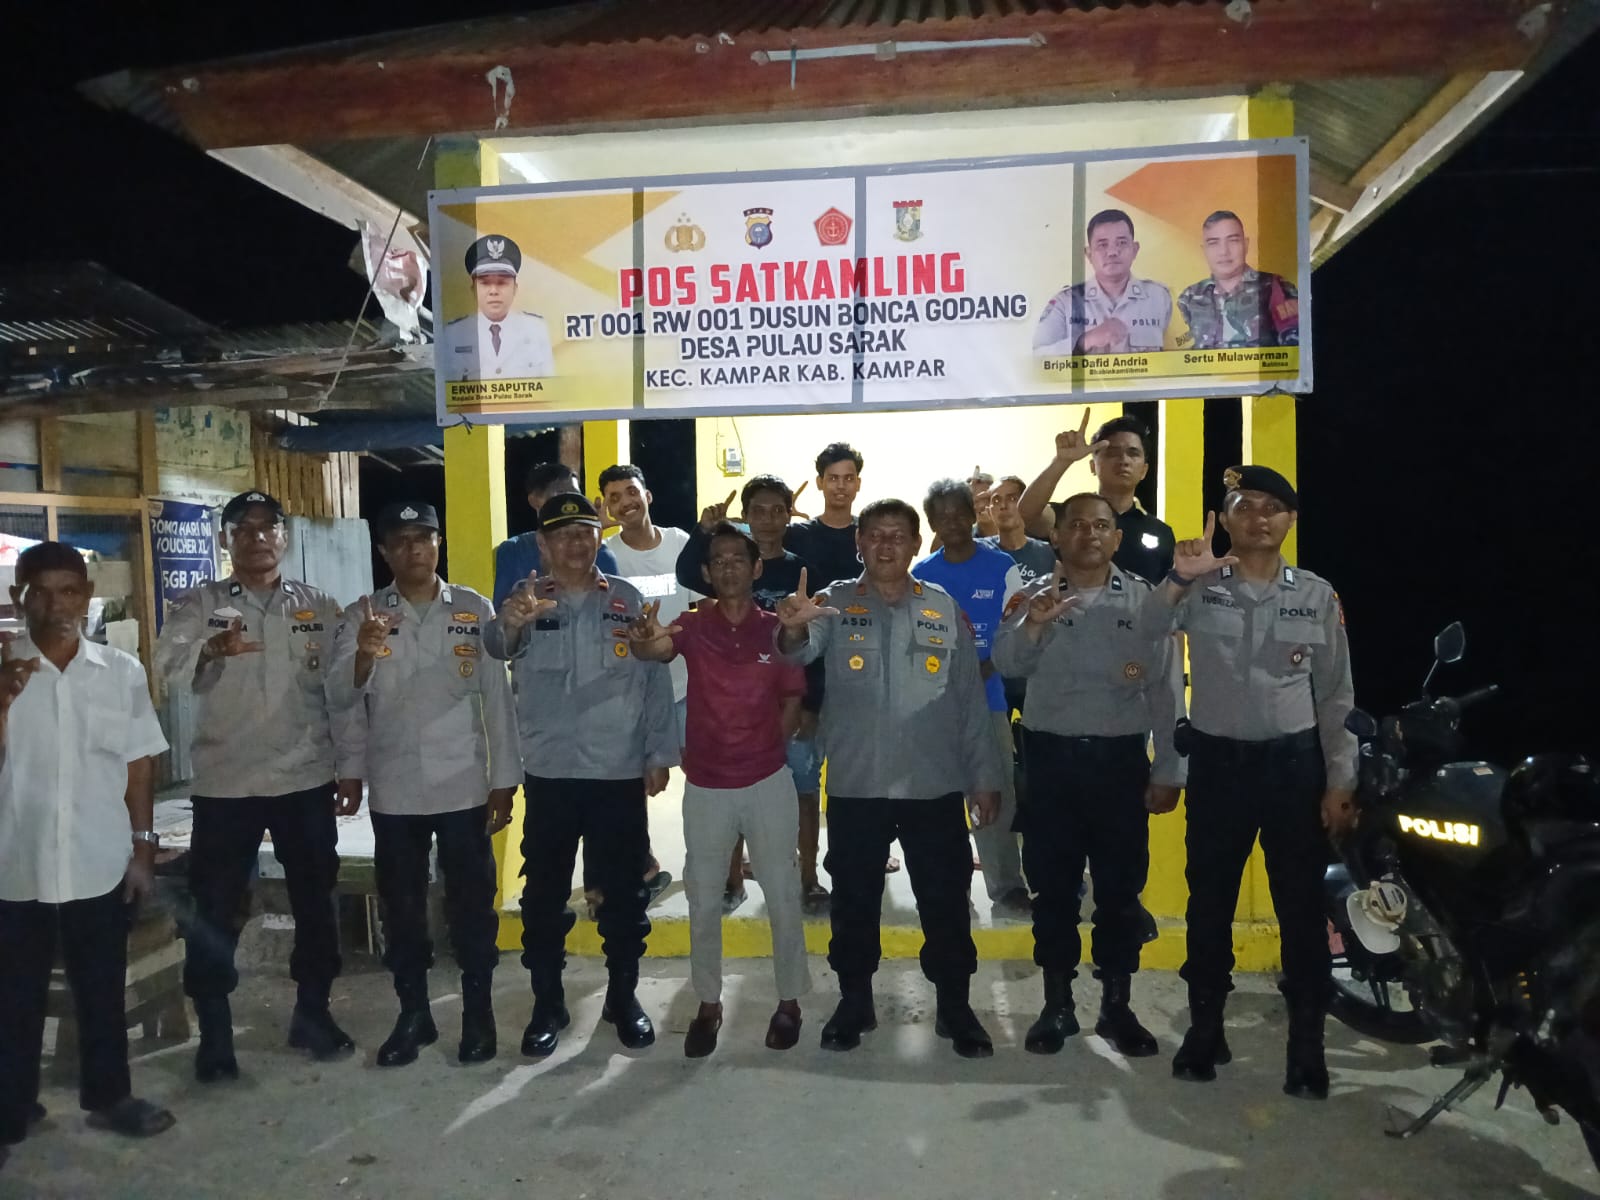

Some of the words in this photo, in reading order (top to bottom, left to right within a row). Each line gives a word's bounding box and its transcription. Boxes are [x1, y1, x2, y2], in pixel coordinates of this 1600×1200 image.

[620, 265, 697, 308] POS
[710, 252, 965, 304] SATKAMLING
[567, 314, 595, 338] RT
[601, 312, 646, 337] 001
[653, 310, 692, 333] RW
[698, 308, 744, 332] 001
[750, 304, 831, 330] DUSUN
[838, 299, 920, 326] BONCA
[925, 294, 1027, 322] GODANG
[681, 336, 740, 361] DESA
[747, 332, 822, 358] PULAU
[829, 329, 907, 355] SARAK
[1184, 353, 1214, 363] Sertu
[1217, 351, 1288, 362] Mulawarman
[1044, 359, 1079, 372] Bripka
[1081, 358, 1109, 369] Dafid
[1113, 356, 1148, 367] Andria
[646, 369, 693, 388] KEC.
[700, 364, 790, 386] KAMPAR
[797, 364, 845, 382] KAB.
[853, 359, 946, 380] KAMPAR
[451, 384, 487, 394] ERWIN
[491, 382, 543, 392] SAPUTRA
[602, 613, 634, 623] POL
[1280, 607, 1317, 618] POLRI
[841, 617, 872, 627] ASDI
[917, 620, 949, 632] POLRI
[291, 623, 324, 634] POLRI
[447, 625, 480, 635] POLRI
[1398, 814, 1479, 846] POLISI
